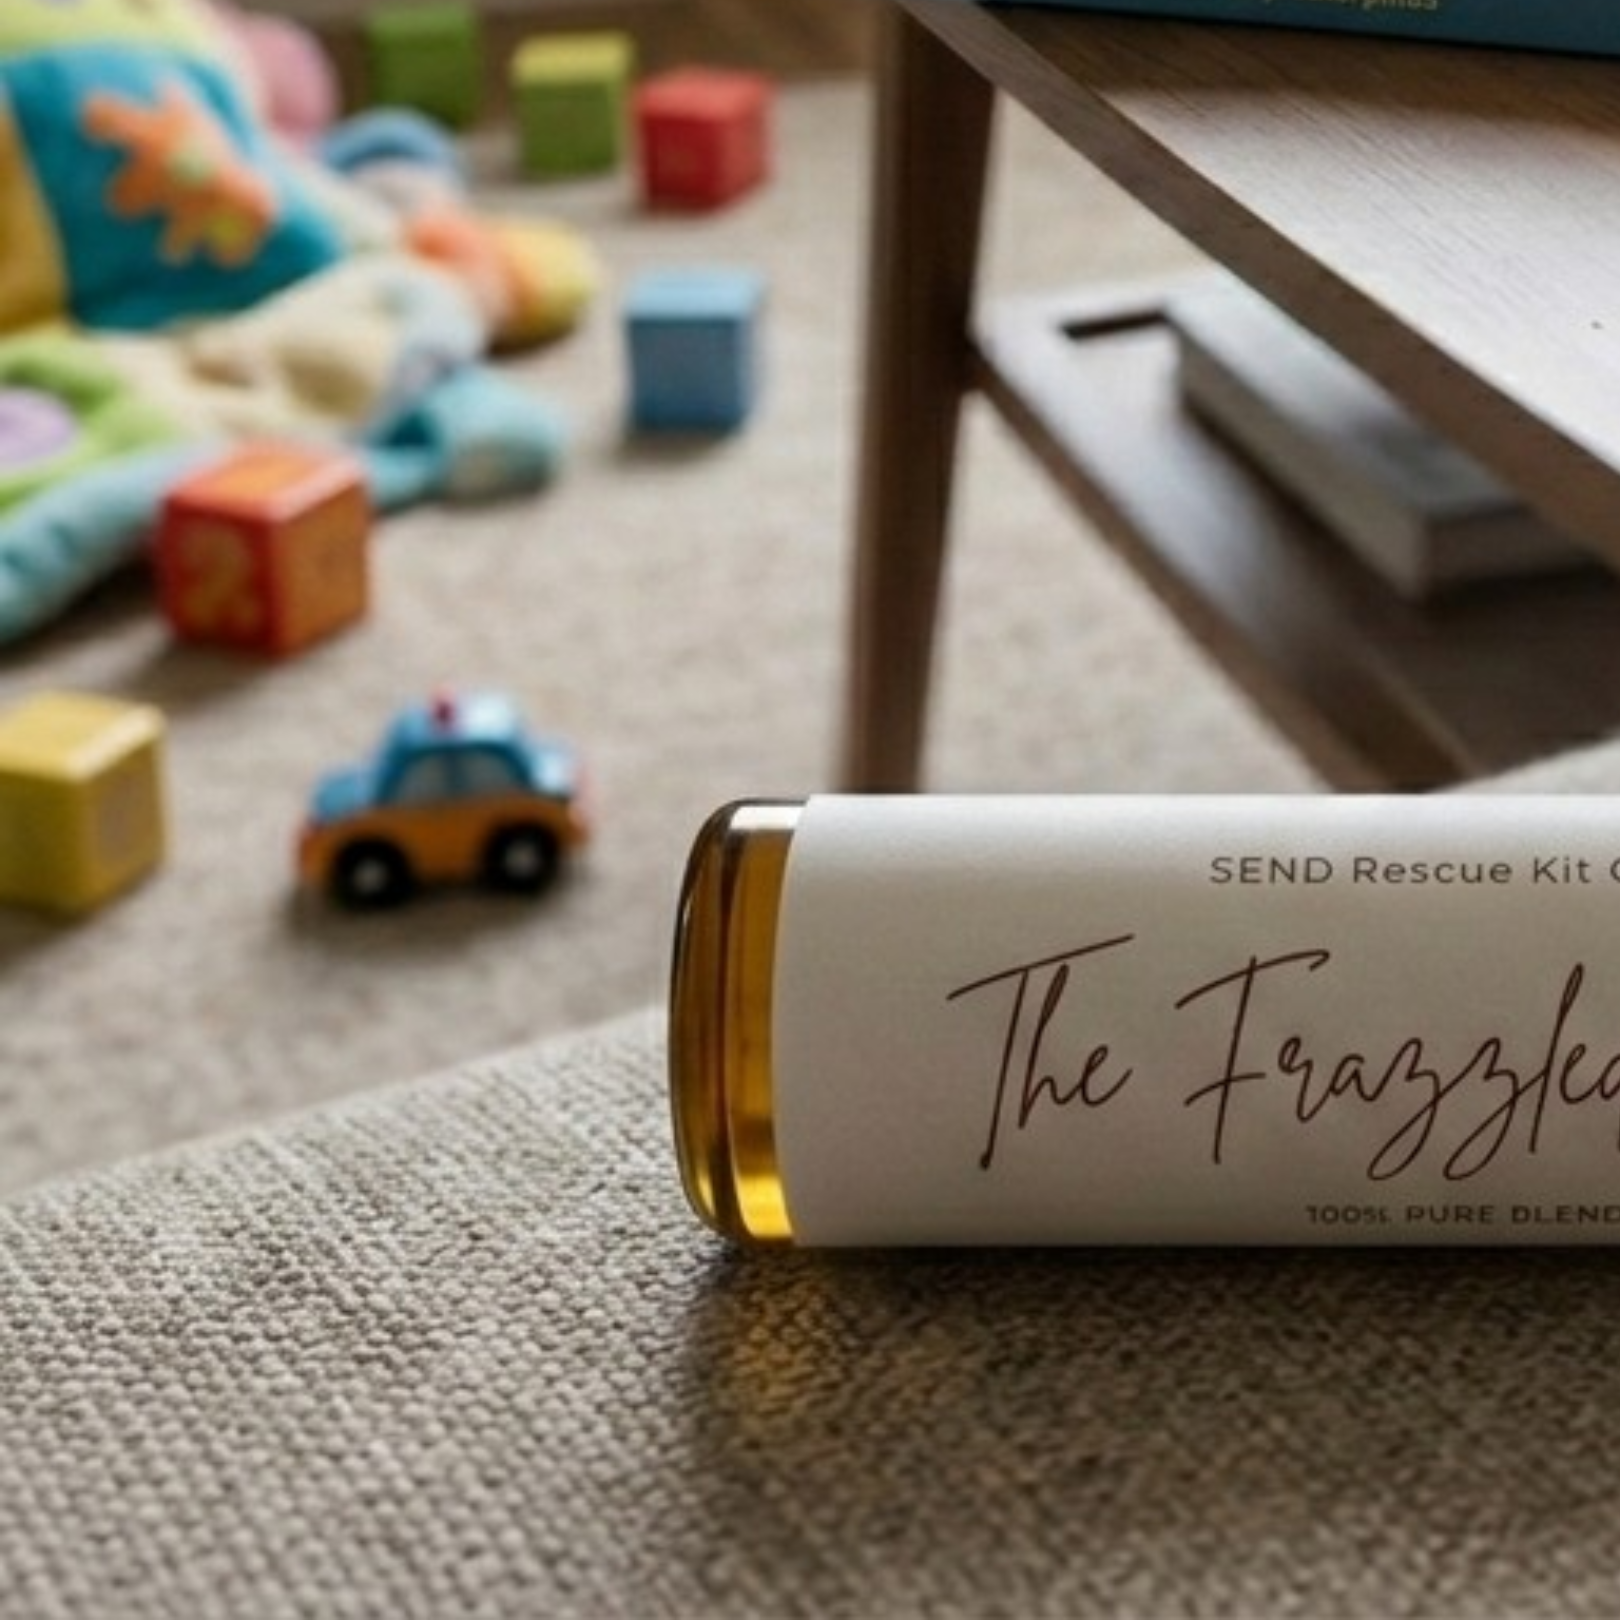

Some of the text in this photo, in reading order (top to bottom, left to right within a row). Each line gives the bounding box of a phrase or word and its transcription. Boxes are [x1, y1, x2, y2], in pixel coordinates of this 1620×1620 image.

[1210, 856, 1333, 884] SEND
[1353, 856, 1512, 884] Rescue
[1533, 856, 1591, 884] Kit
[946, 933, 1135, 1171] The
[1406, 1204, 1495, 1226] PURE
